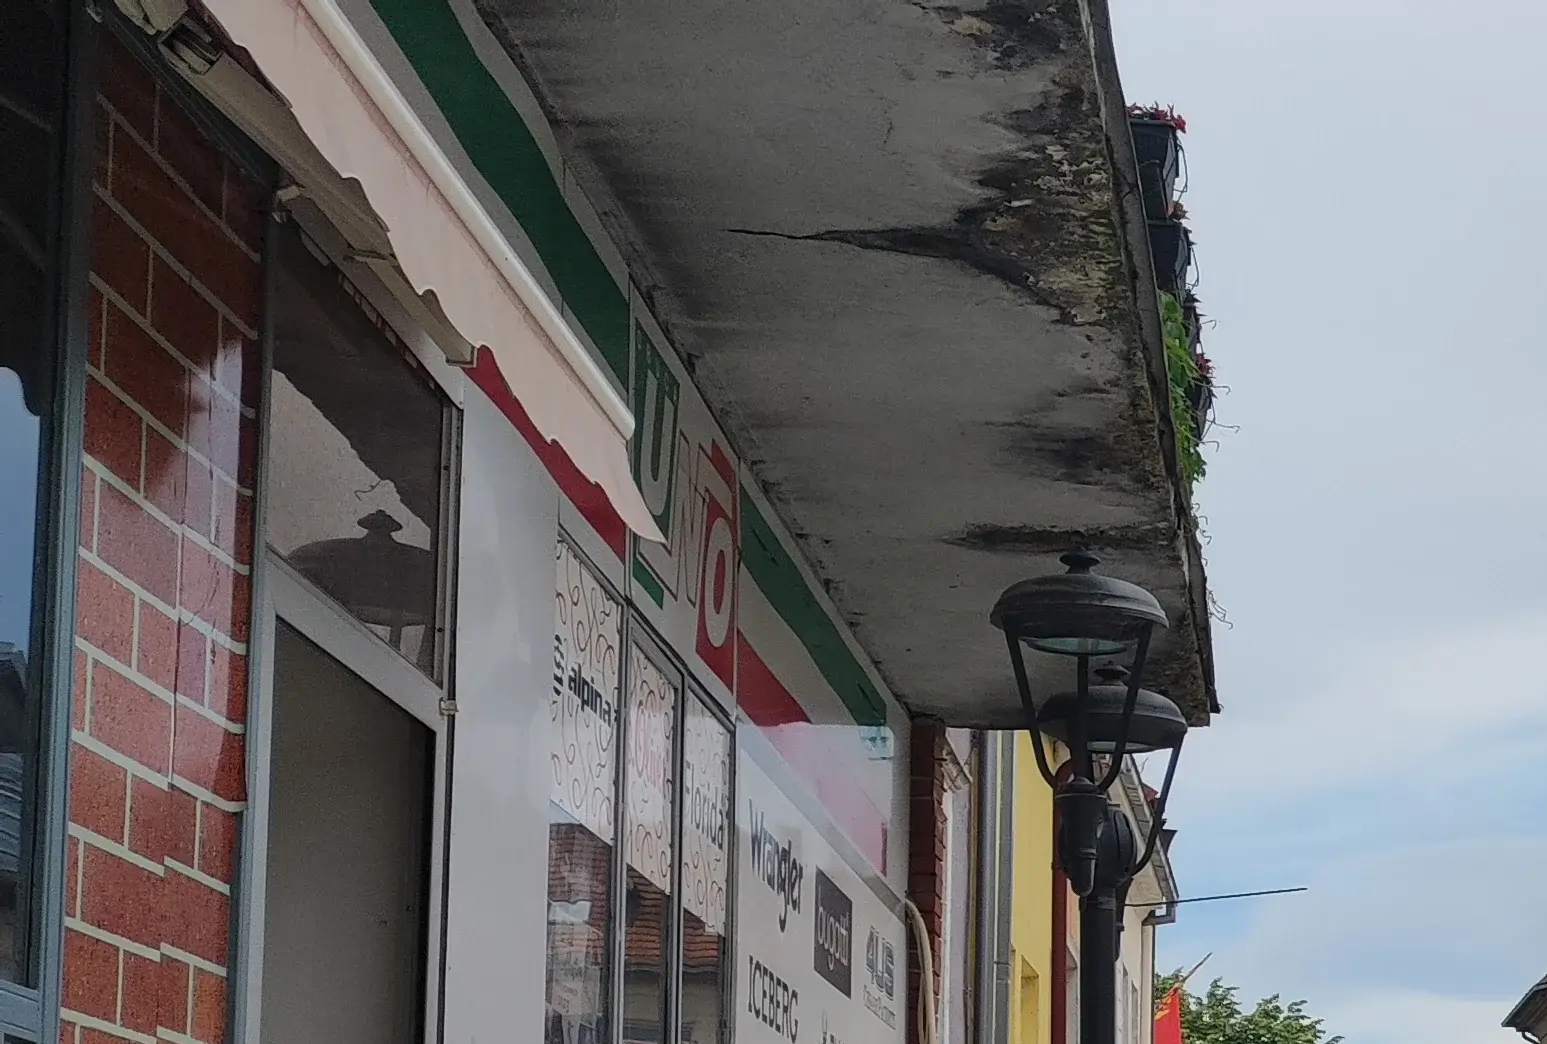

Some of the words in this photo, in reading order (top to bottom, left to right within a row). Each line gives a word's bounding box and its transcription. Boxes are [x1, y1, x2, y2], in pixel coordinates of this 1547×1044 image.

[567, 662, 613, 728] alpina
[685, 768, 727, 852] Florida
[749, 798, 803, 933] Wrangler
[816, 888, 850, 970] bugatti
[748, 955, 799, 1044] ICEBERG
